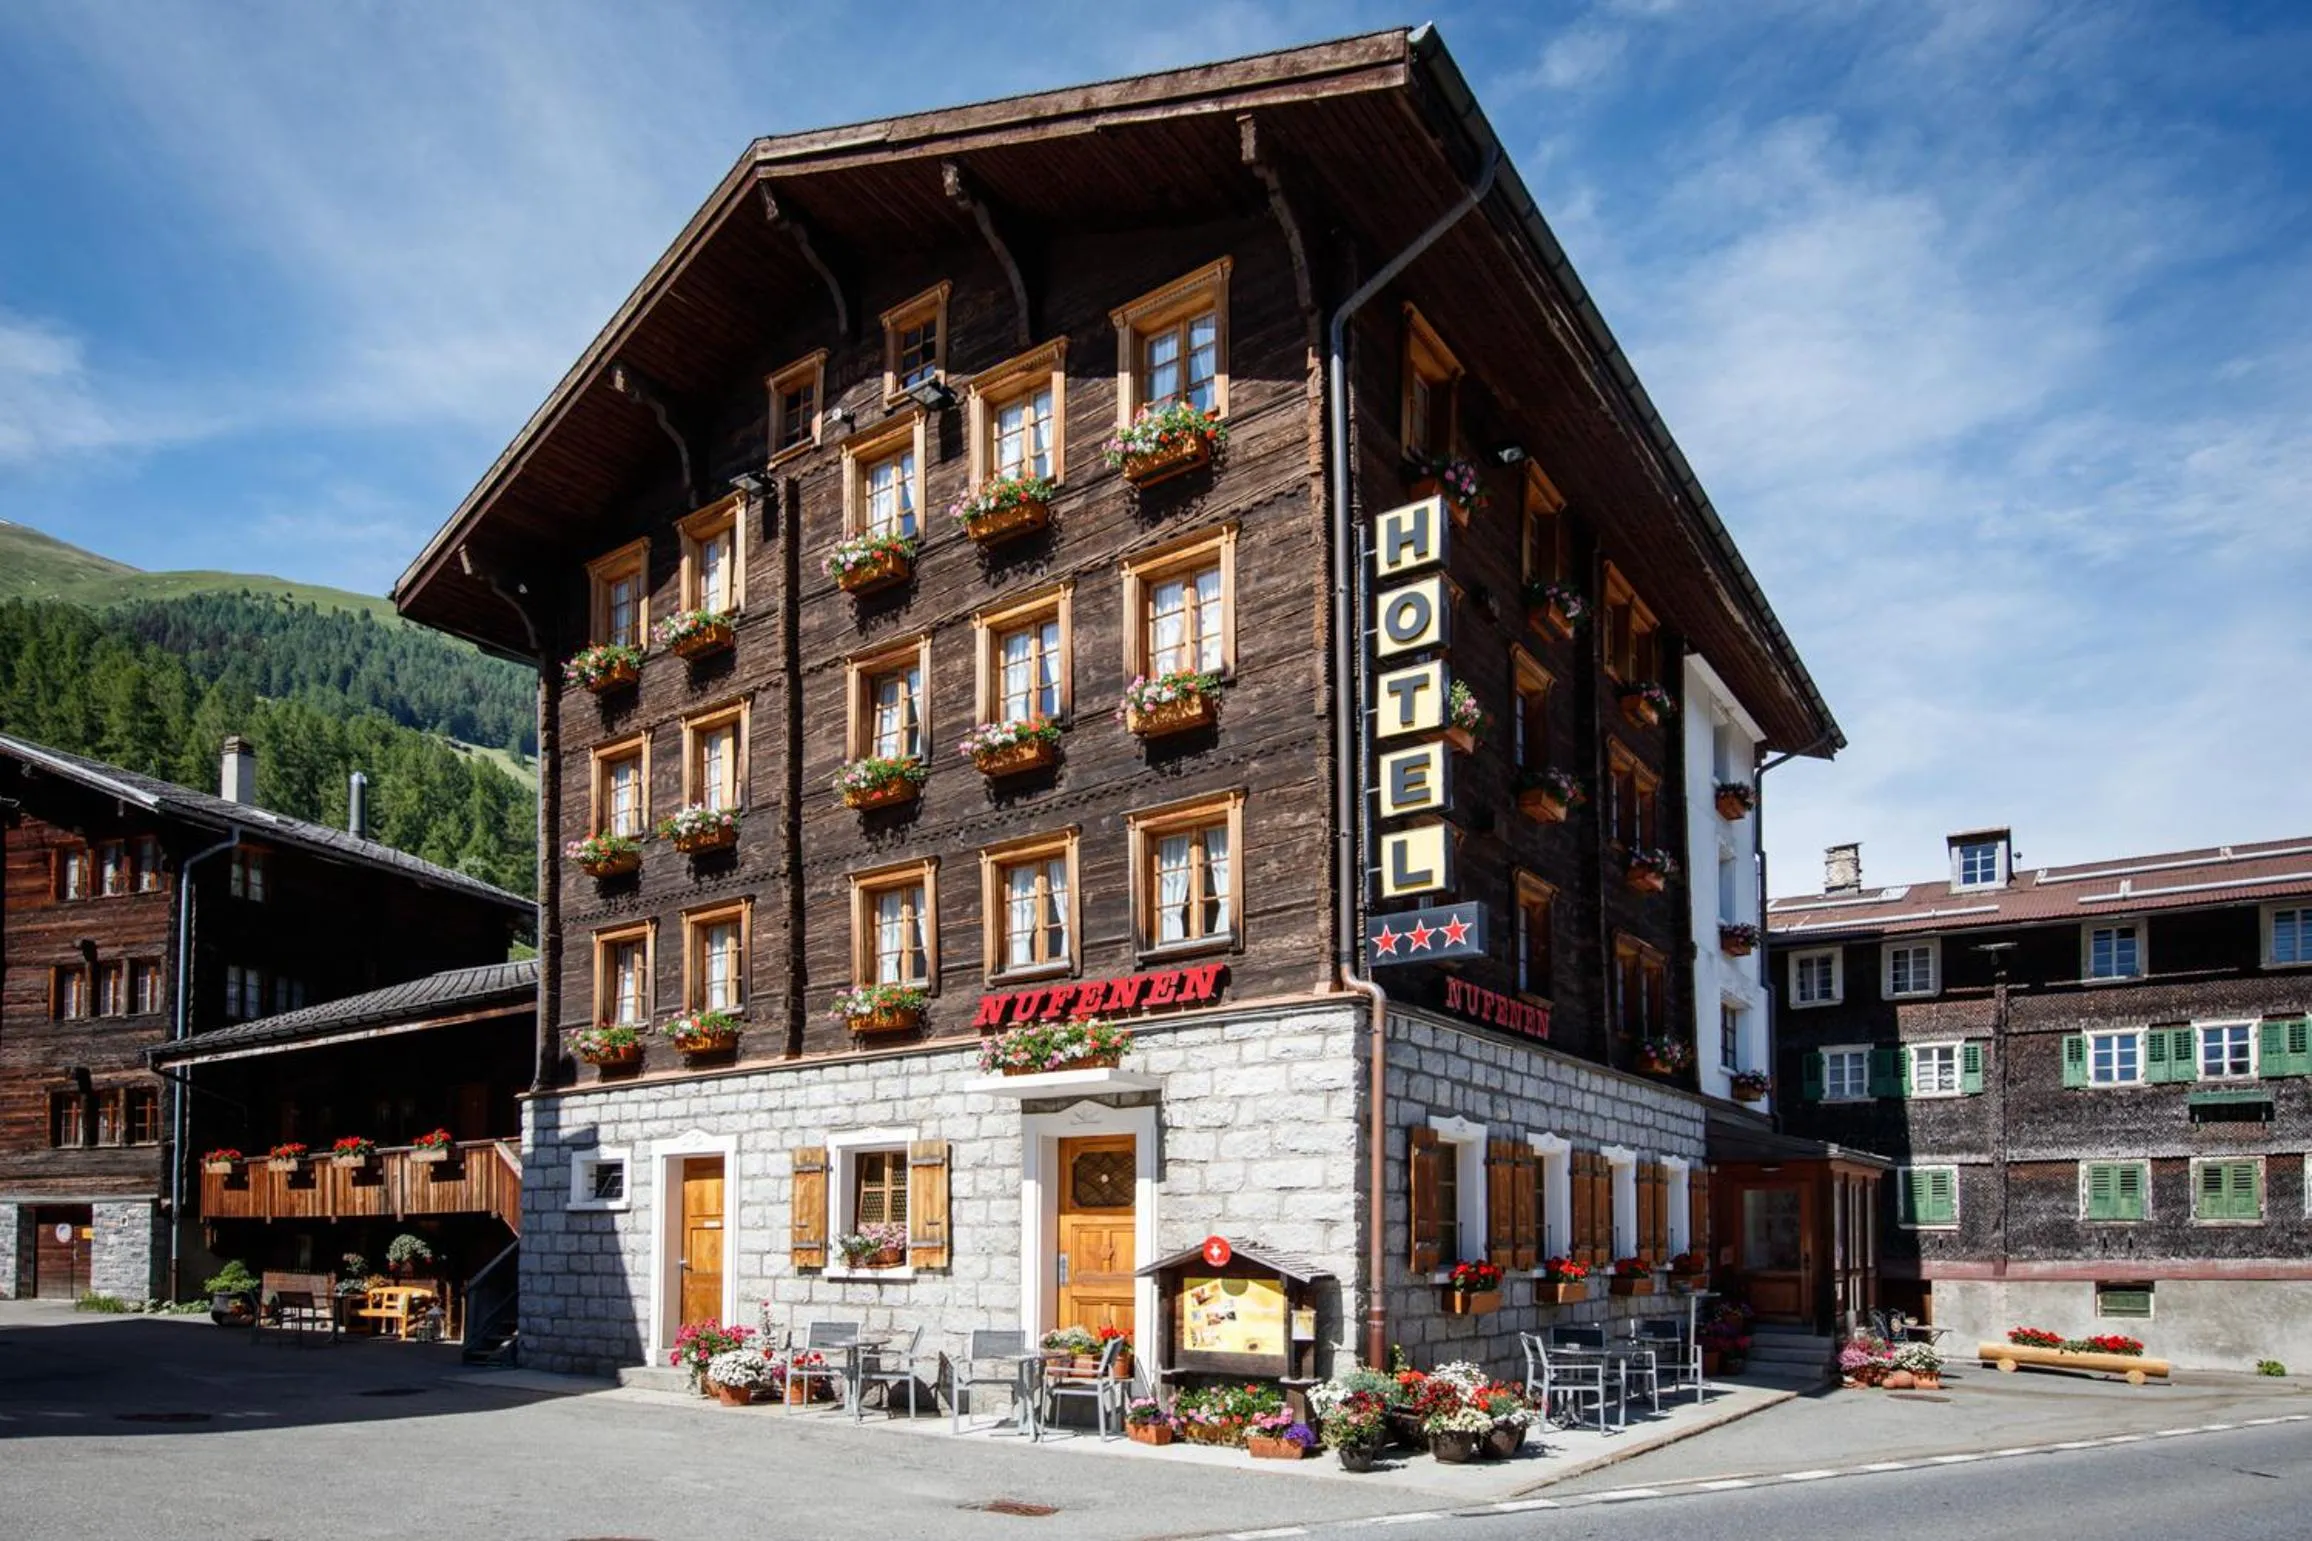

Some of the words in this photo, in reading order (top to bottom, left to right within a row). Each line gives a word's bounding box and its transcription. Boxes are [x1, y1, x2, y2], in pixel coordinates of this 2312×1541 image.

[1384, 505, 1433, 892] HOTEL
[972, 962, 1225, 1027] NUFENEN
[1445, 975, 1549, 1040] NUFENEN
